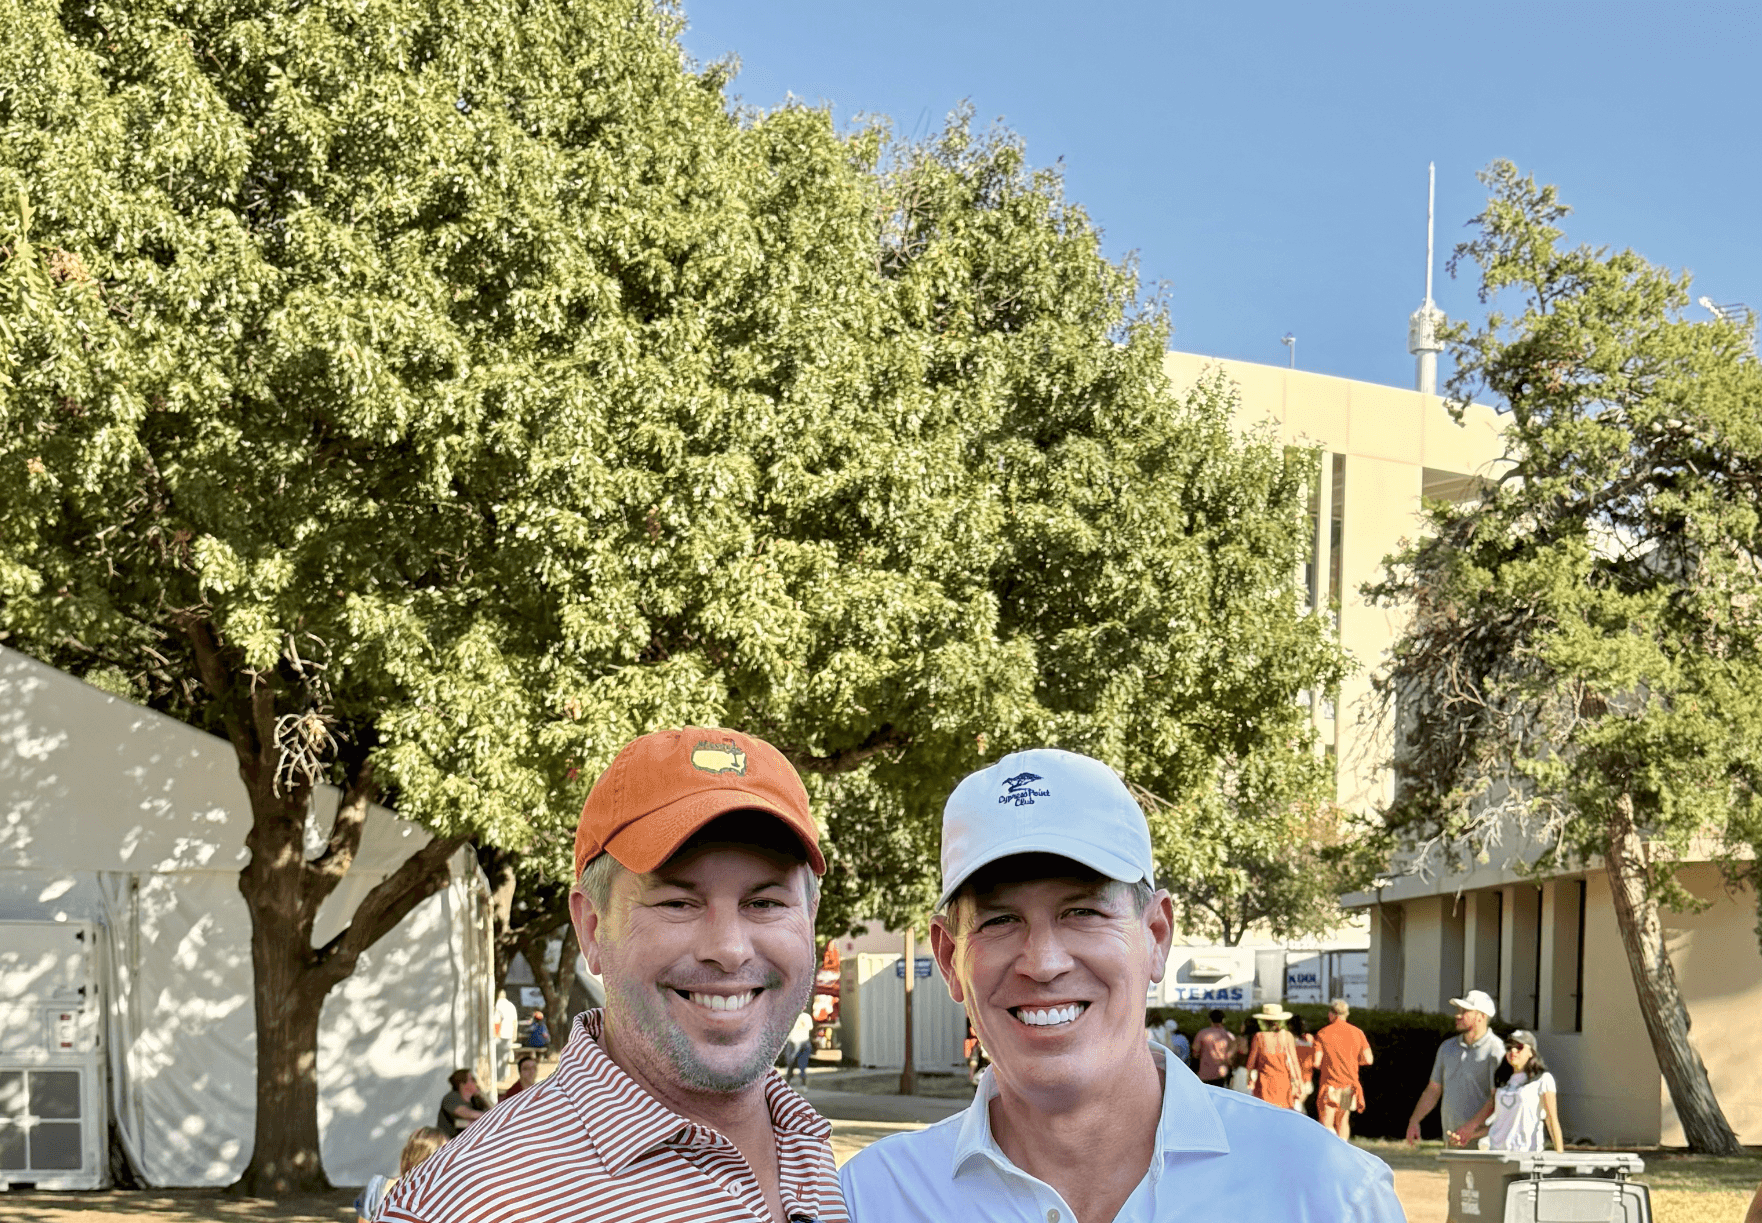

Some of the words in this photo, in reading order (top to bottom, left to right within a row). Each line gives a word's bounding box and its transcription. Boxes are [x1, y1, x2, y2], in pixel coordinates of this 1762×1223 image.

[1028, 788, 1051, 797] Point
[1015, 797, 1035, 807] Club
[1175, 987, 1243, 1001] TEXAS
